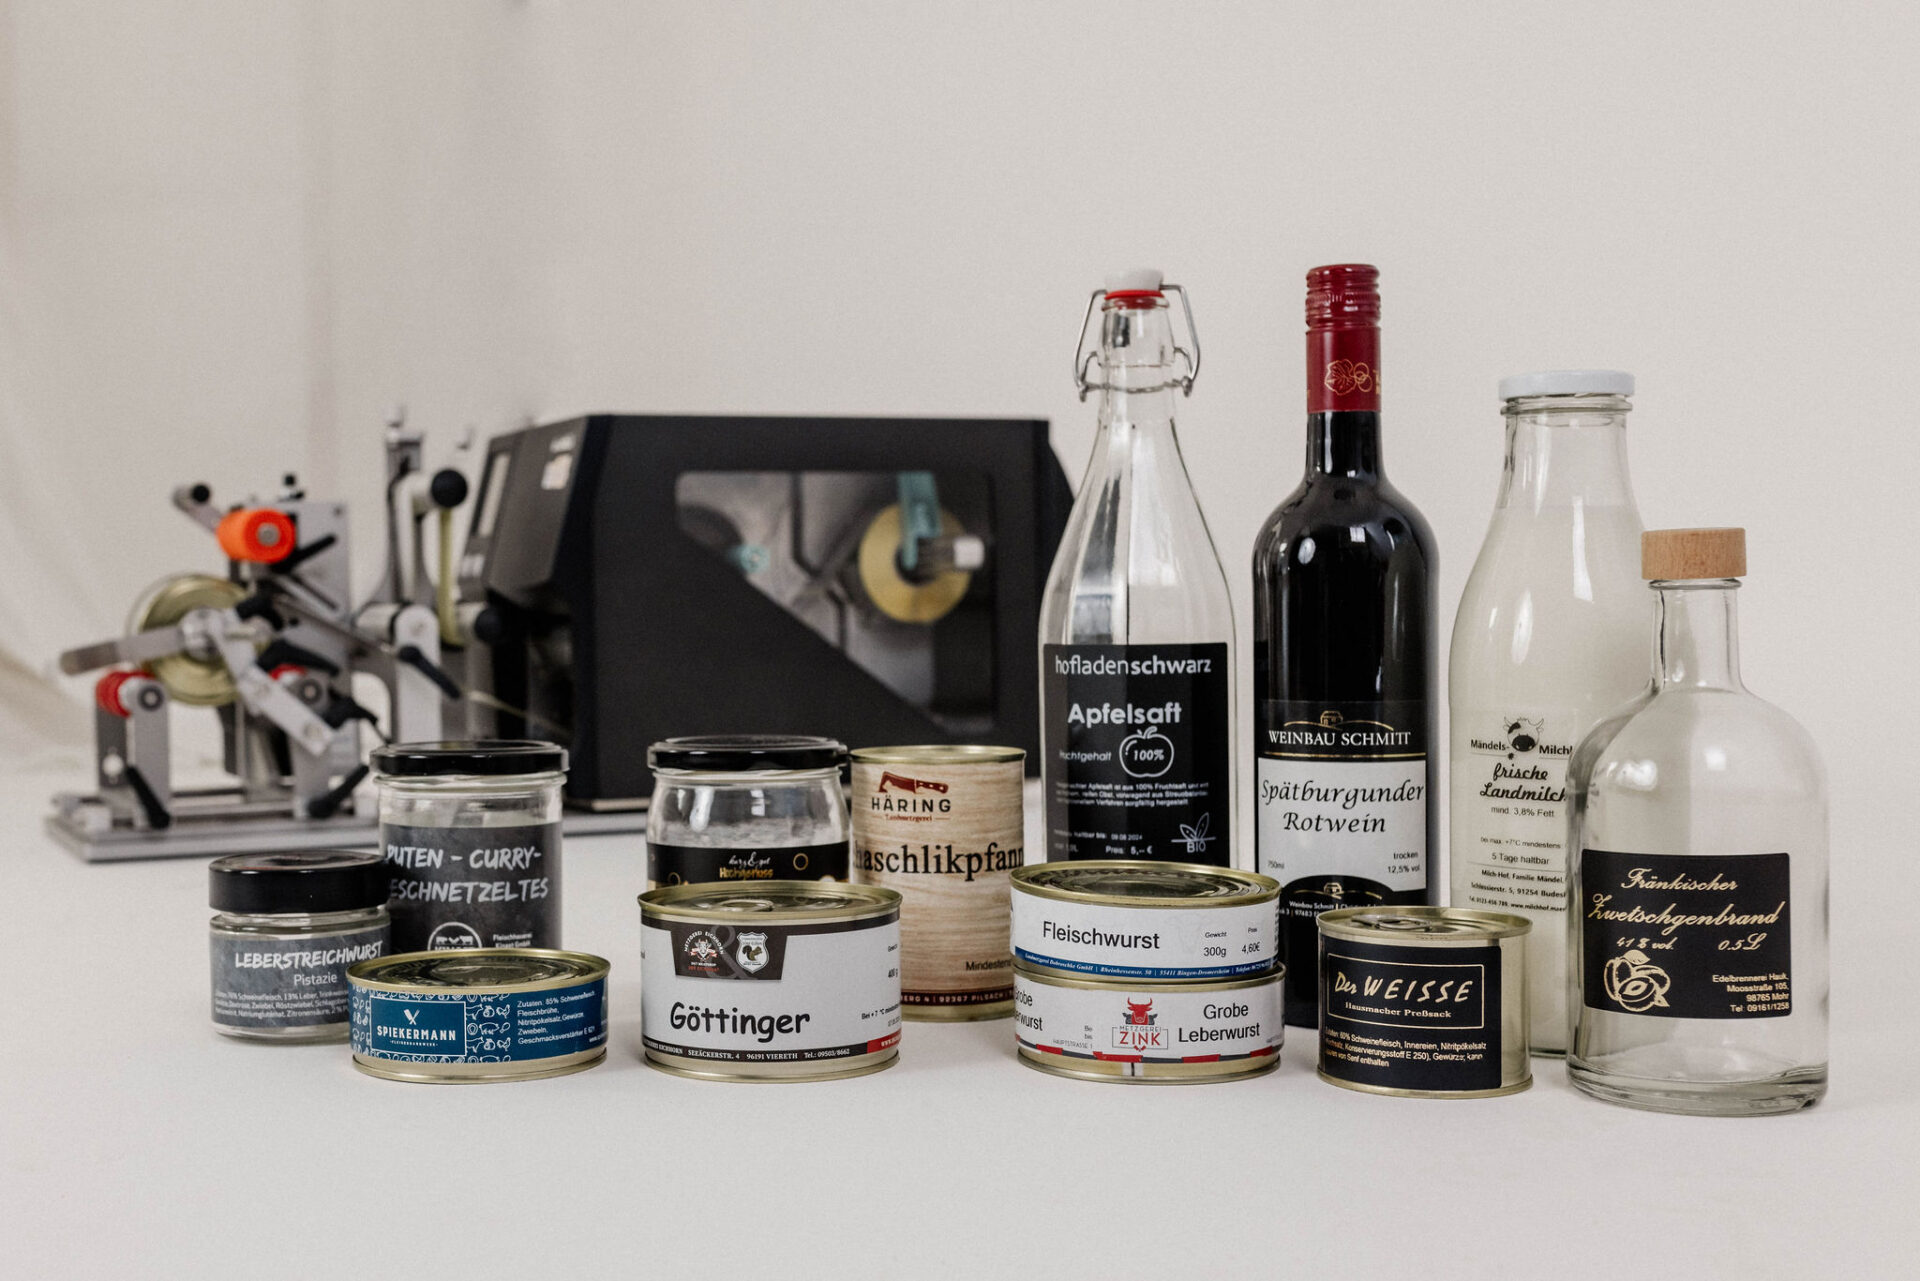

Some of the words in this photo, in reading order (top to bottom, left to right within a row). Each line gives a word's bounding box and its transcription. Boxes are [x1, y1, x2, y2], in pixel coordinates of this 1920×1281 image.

[1055, 654, 1211, 675] hofladenschwarz
[1068, 702, 1182, 729] Apfelsaft
[1268, 730, 1335, 746] WEINBAU
[1341, 731, 1411, 746] SCHMITT
[1133, 749, 1165, 761] 100%
[1493, 762, 1548, 781] frische
[1261, 779, 1424, 810] Spätburgunder
[871, 794, 951, 813] HÄRING
[1537, 809, 1554, 818] Fett
[1283, 812, 1386, 833] Rotwein
[1187, 842, 1206, 853] BIO
[1393, 851, 1418, 860] trocken
[386, 844, 444, 869] PUTEN
[469, 846, 542, 870] CURRY-
[1492, 852, 1497, 860] 5
[1499, 853, 1519, 863] Tage
[1520, 856, 1550, 865] haltbar
[1512, 873, 1535, 881] Familie
[1621, 867, 1738, 891] Fränkischer
[390, 877, 549, 904] ESCHNETZELTES
[1516, 887, 1539, 896] 91254
[1588, 893, 1786, 936] Zwetschgenbrand
[1043, 920, 1160, 949] Fleischwurst
[1205, 931, 1227, 939] Gewicht
[235, 940, 383, 970] LEBERSTREICHWURST
[1203, 947, 1227, 958] 300g
[1241, 941, 1261, 955] 4,60€
[293, 972, 338, 987] Pistazie
[1334, 971, 1358, 995] Der
[1363, 975, 1474, 1003] WEISSE
[1203, 1002, 1249, 1020] Grobe
[1345, 1001, 1401, 1016] Hausmacher
[1404, 1009, 1452, 1018] Preßsack
[670, 1001, 810, 1043] Göttinger
[377, 1025, 456, 1041] SPIEKERMANN
[1119, 1031, 1161, 1046] ZINK
[1178, 1022, 1260, 1043] Leberwurst
[1404, 1040, 1439, 1050] Innereien,
[766, 1052, 798, 1060] VIERETH
